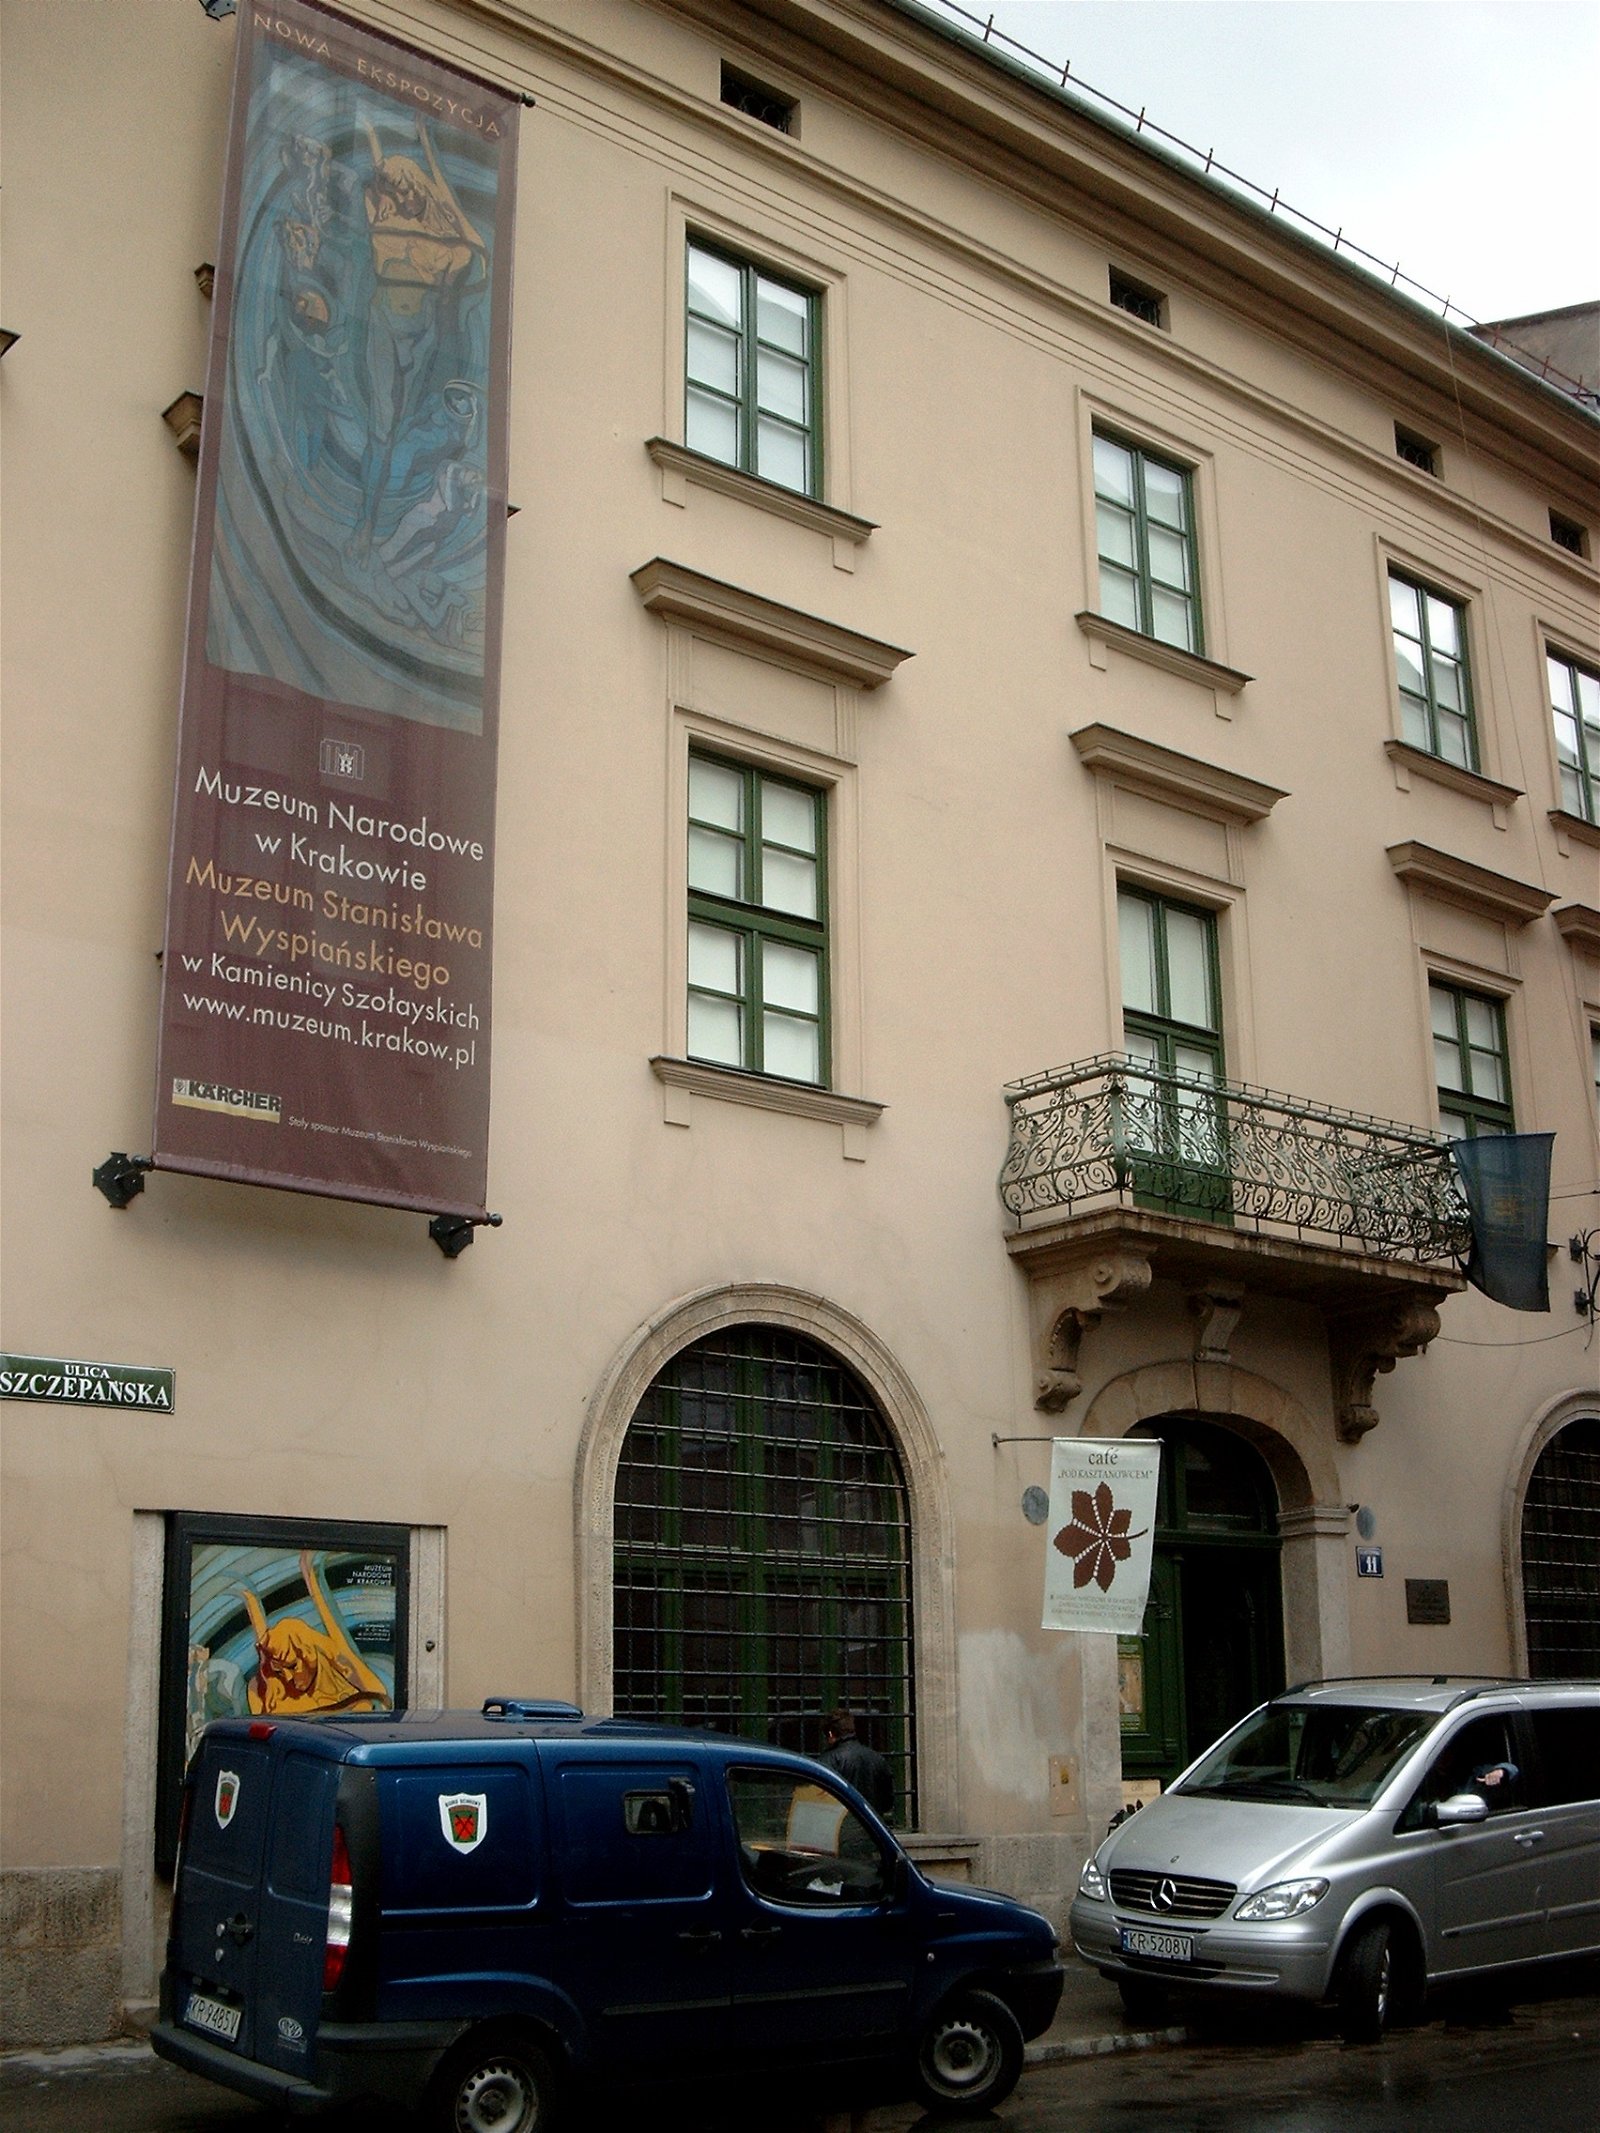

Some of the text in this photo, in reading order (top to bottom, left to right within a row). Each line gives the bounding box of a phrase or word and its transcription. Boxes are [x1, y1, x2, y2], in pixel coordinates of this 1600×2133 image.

[253, 12, 500, 137] NOWA EKSPOZYCJA
[195, 766, 484, 861] Muzeum Narodowe
[255, 832, 427, 890] w Krakowie
[186, 856, 483, 948] Muzeum Stanisława
[220, 909, 450, 990] Wyspiańskiego
[181, 952, 480, 1031] w Kamienicy Szołayskich
[182, 992, 476, 1070] www.muzeum.krakow.pl
[0, 1371, 170, 1407] SZCZEPAŃSKA
[64, 1364, 111, 1380] ULICA
[1088, 1447, 1120, 1466] café
[1366, 1555, 1378, 1574] 11
[1129, 1932, 1189, 1956] KR 5208V
[205, 2004, 241, 2034] 9485V
